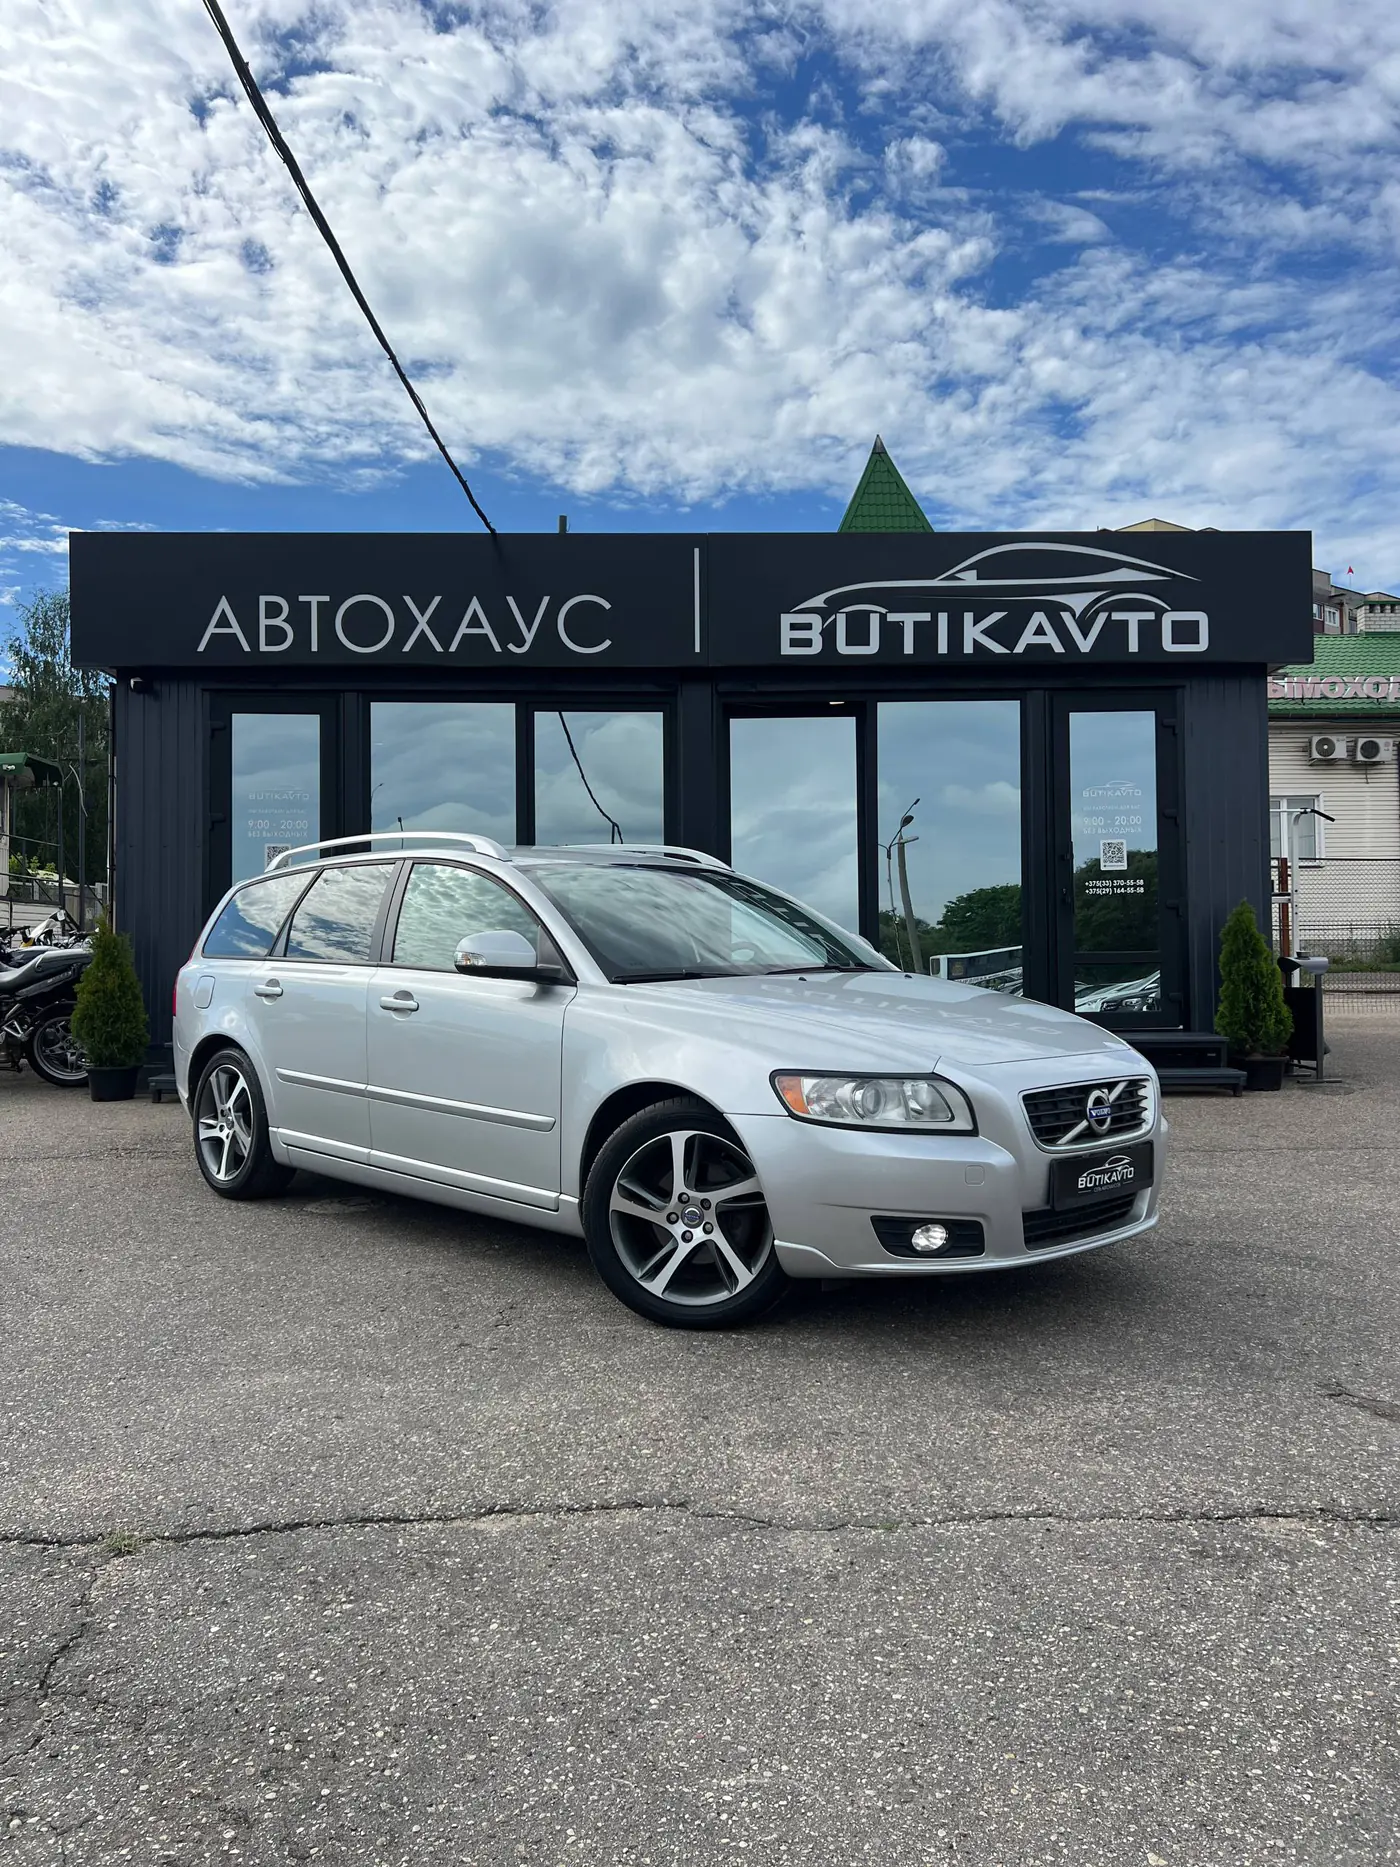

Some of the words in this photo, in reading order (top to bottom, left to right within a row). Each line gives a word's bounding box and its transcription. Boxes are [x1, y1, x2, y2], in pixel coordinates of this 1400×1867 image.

[197, 593, 612, 654] АВТОХАУС
[780, 610, 1209, 655] BUTIKAVTO
[249, 792, 309, 800] BUTIKAVTO
[1082, 789, 1141, 797] BUTIKAVTO
[248, 820, 270, 829] 9:00
[281, 820, 308, 829] 20:00
[1083, 817, 1104, 825] 9:00
[1115, 816, 1142, 825] 20:00
[1085, 880, 1112, 888] +375(33)
[1113, 879, 1144, 887] 370-55-58
[1085, 888, 1112, 896] +375(29)
[1078, 1167, 1134, 1188] BUTIKAVTO
